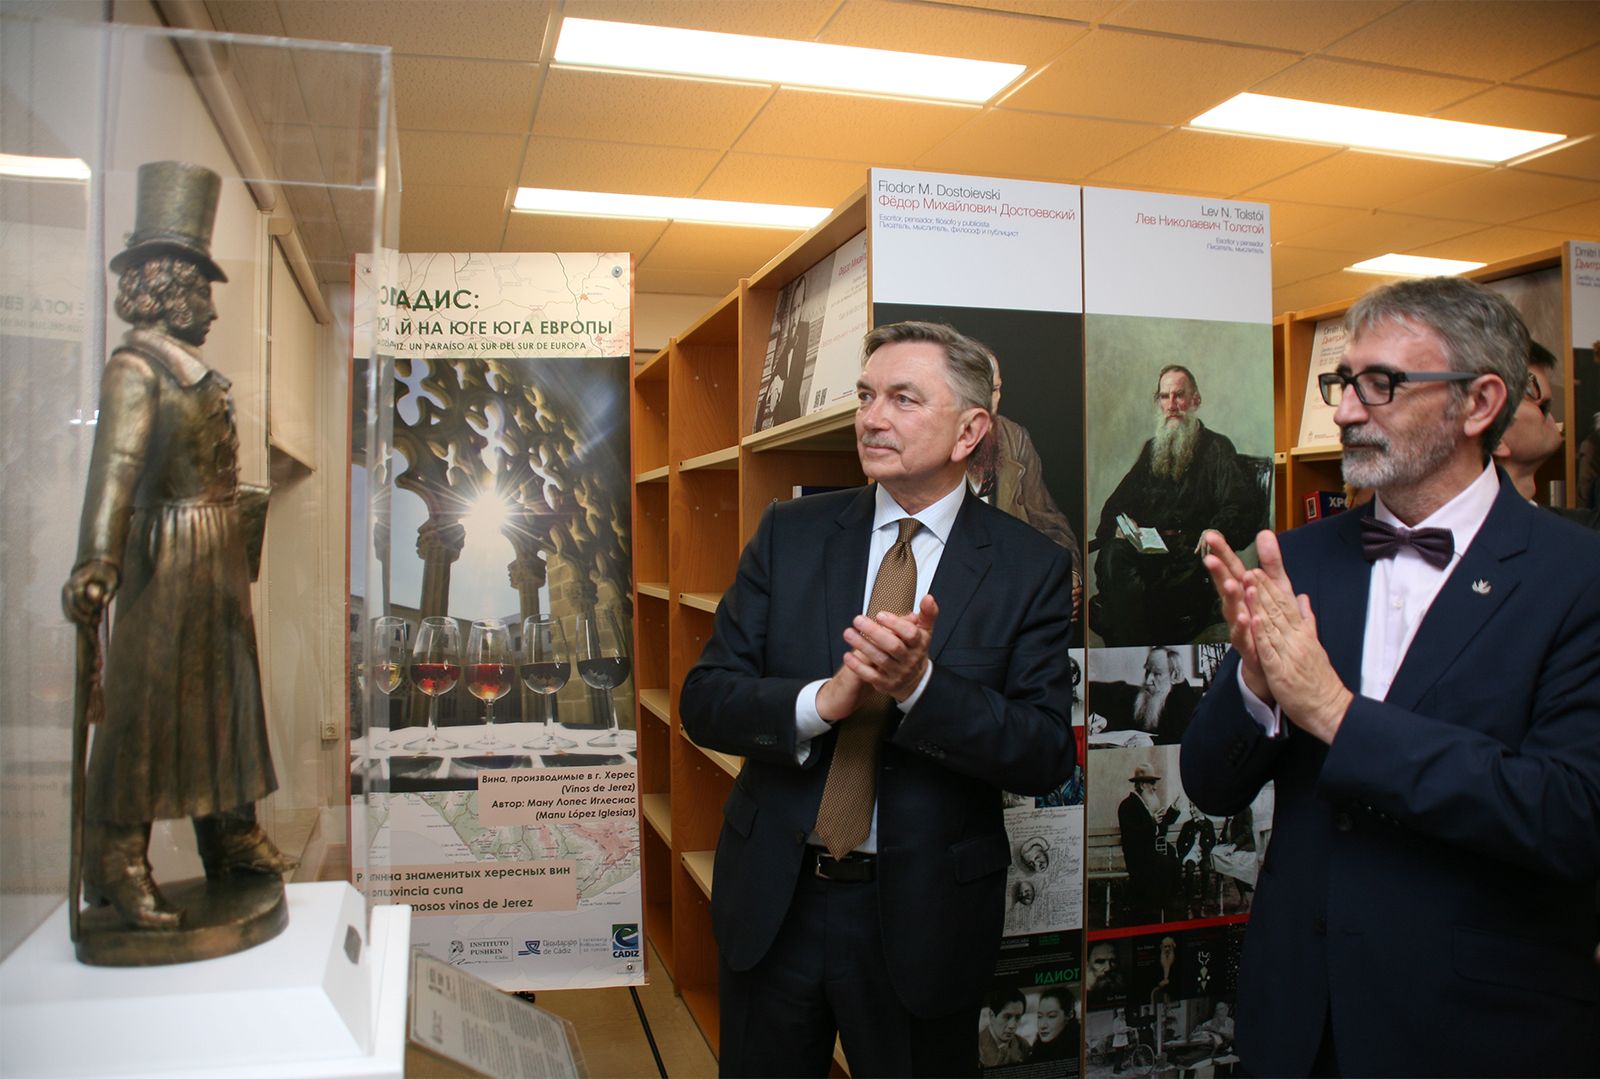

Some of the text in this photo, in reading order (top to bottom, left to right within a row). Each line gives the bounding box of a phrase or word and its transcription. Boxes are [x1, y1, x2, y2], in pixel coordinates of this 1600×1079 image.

[878, 180, 1000, 200] Fiodor M. Dostoievski
[878, 194, 1075, 221] Фёдор Михайлович Достоевский
[1201, 205, 1219, 217] Lev
[1221, 207, 1232, 218] N.
[1136, 213, 1264, 234] Лев Николаевич Толстой
[418, 321, 443, 335] НА
[450, 321, 487, 335] ЮГЕ
[493, 320, 534, 335] ЮГА
[540, 320, 611, 335] ЕВРОПЫ
[409, 342, 422, 350] UN
[425, 340, 465, 350] PARAÍSO
[467, 342, 478, 350] AL
[481, 342, 497, 350] SUR
[500, 342, 515, 350] DEL
[518, 342, 534, 350] SUR
[537, 342, 548, 350] DE
[551, 342, 586, 350] EUROPA
[482, 775, 508, 784] Вина,
[511, 773, 584, 784] производимые
[604, 771, 635, 781] Херес
[561, 782, 636, 795] (Vinos de Jerez)
[491, 795, 636, 809] Автор: Ману Лопес Иглесиас
[535, 808, 636, 821] (Manu López Iglesias)
[405, 870, 480, 881] знаменитых
[484, 866, 547, 879] хересных
[549, 866, 570, 875] вин
[433, 886, 463, 895] cuna
[449, 900, 480, 911] vinos
[482, 899, 498, 909] de
[502, 898, 533, 909] Jerez
[470, 940, 509, 948] INSTITUTO
[470, 948, 503, 956] PUSHKIN
[1034, 967, 1080, 985] ИДИОТ
